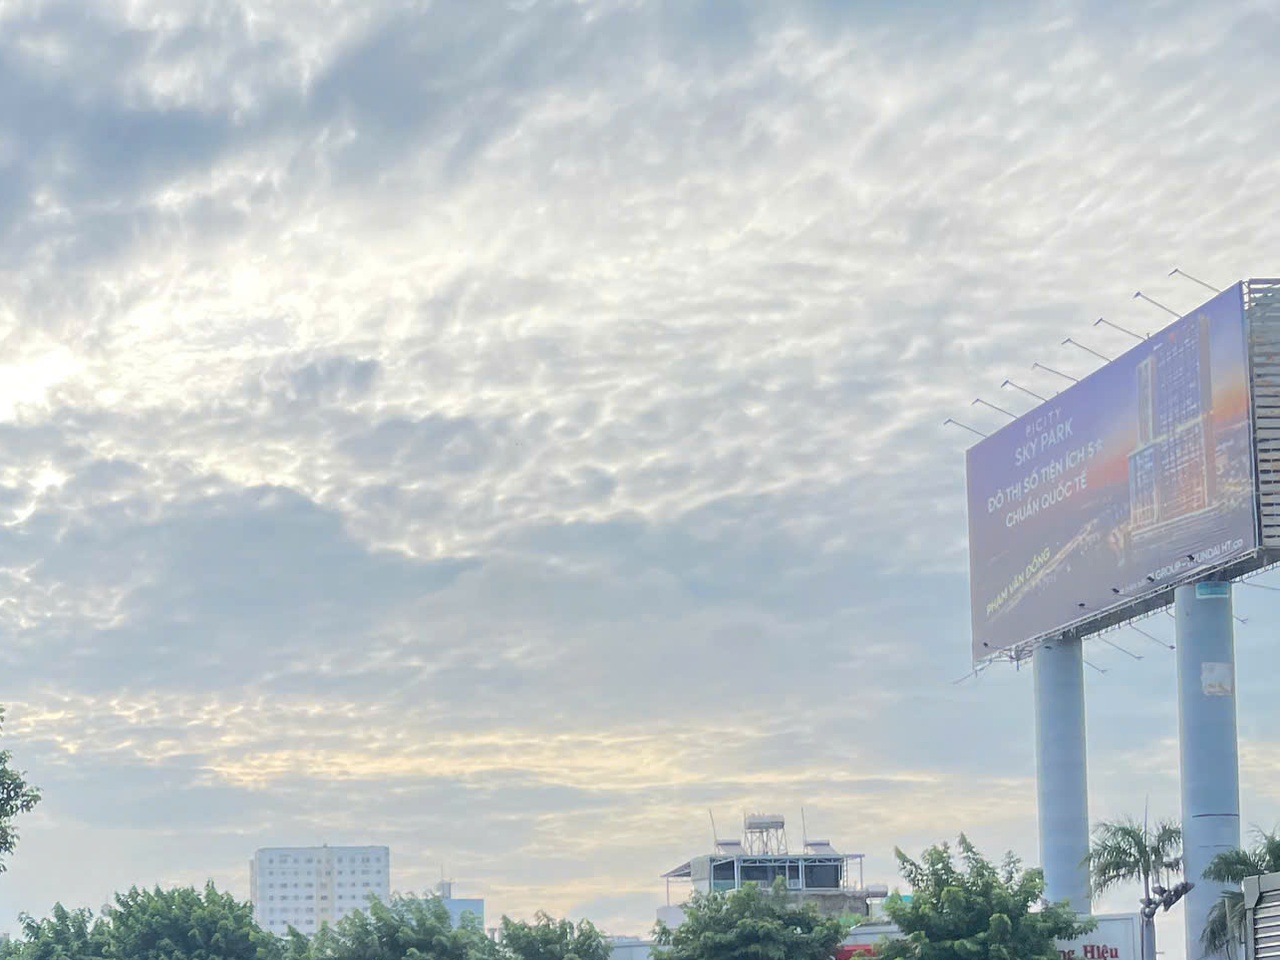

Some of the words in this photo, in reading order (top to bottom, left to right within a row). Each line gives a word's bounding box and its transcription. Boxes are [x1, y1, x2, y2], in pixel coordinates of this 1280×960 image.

[1014, 438, 1038, 466] SKY
[1041, 417, 1073, 451] PARK
[1041, 481, 1073, 509] QUỐC
[1074, 467, 1088, 491] TẾ
